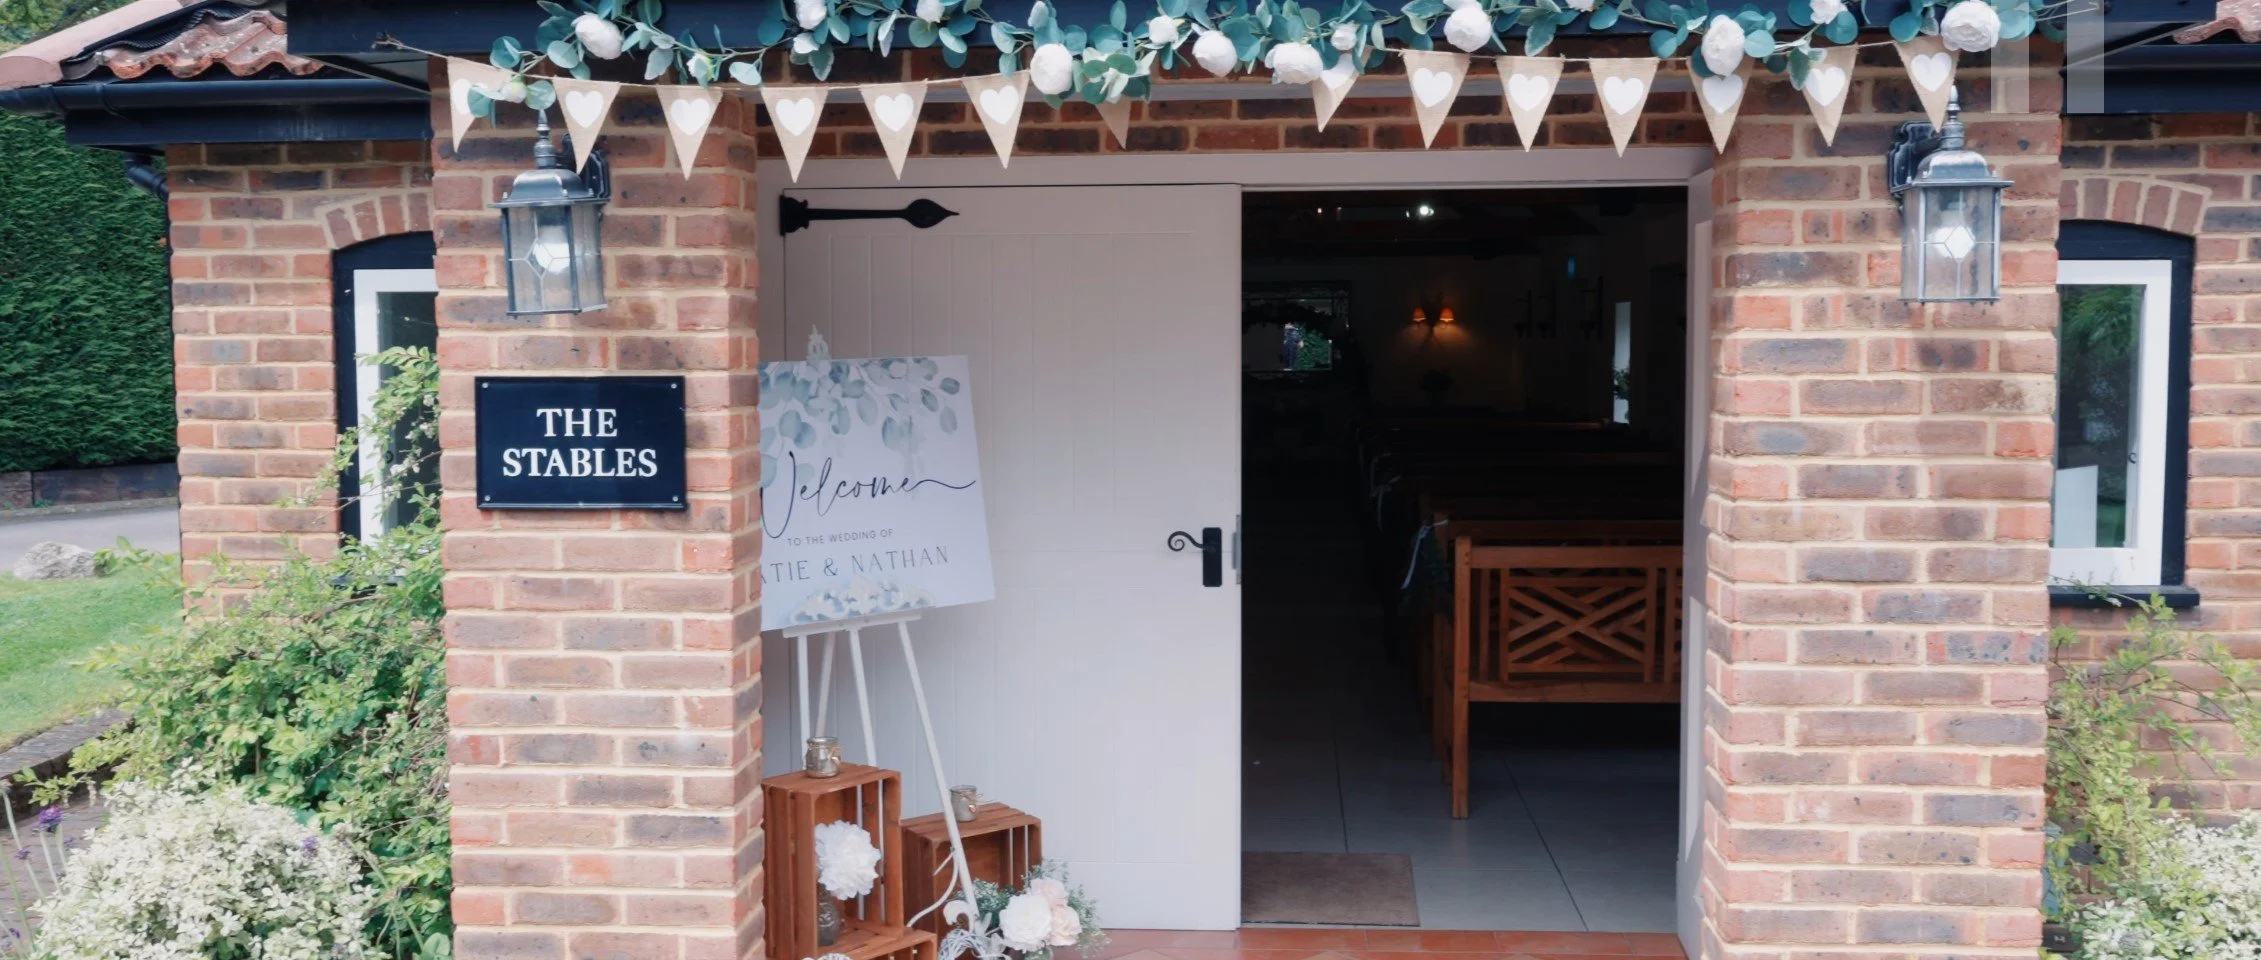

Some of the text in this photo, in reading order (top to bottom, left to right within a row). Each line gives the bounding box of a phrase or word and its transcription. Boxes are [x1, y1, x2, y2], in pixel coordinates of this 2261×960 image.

[536, 408, 618, 437] THE
[502, 448, 658, 477] STABLES
[787, 528, 894, 547] TO THE WEDDING OF
[760, 545, 949, 584] TIE & NATHAN
